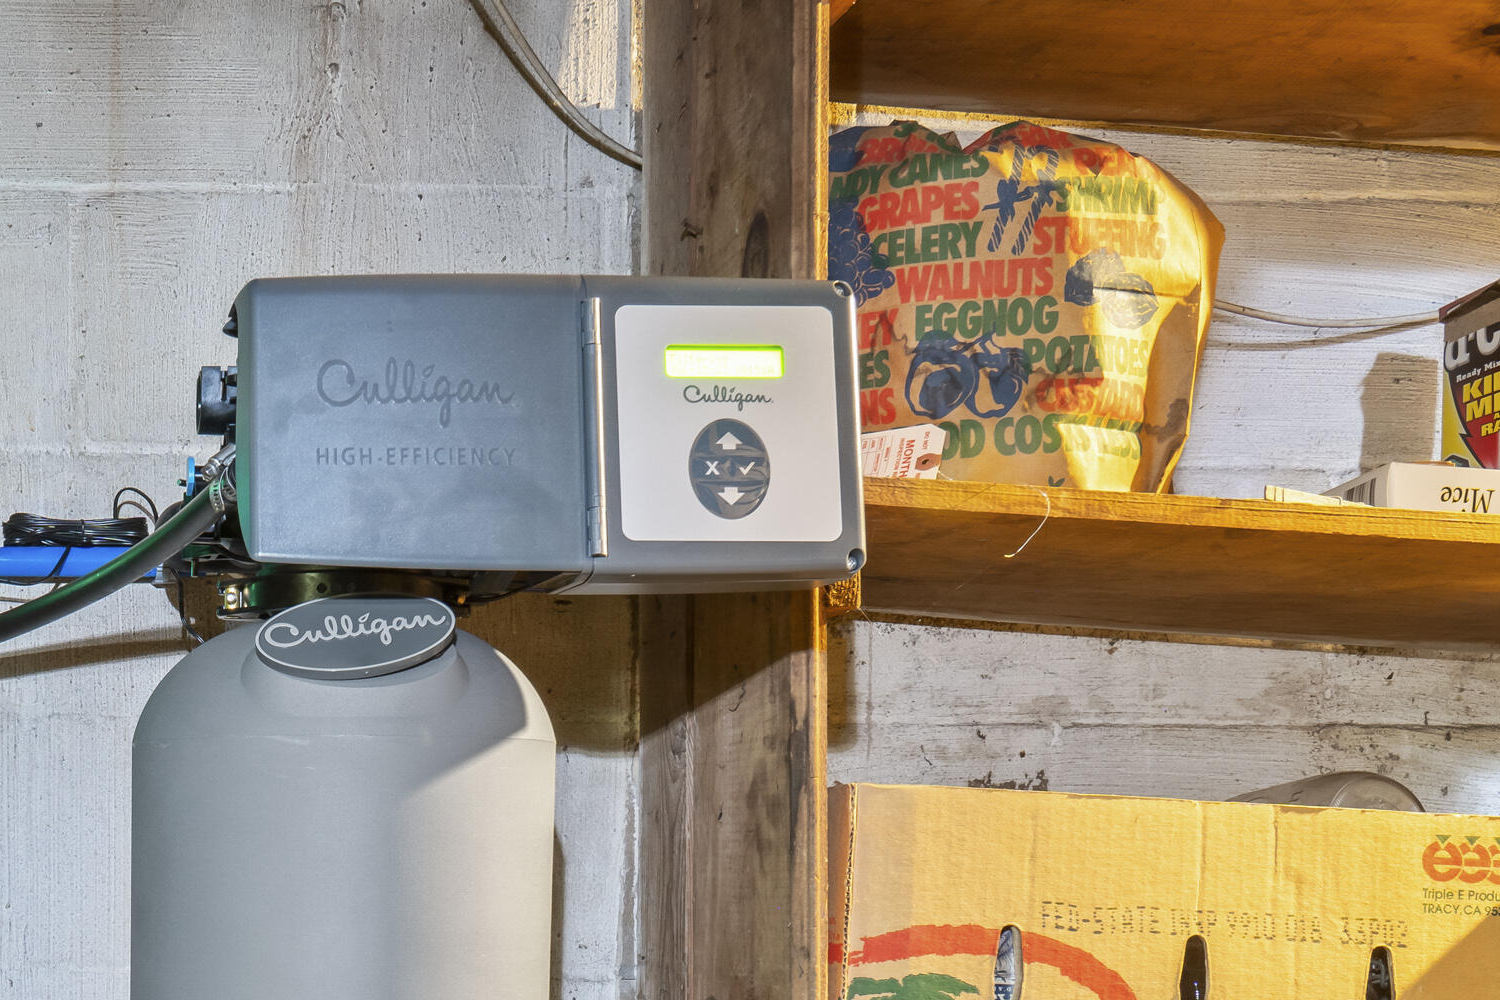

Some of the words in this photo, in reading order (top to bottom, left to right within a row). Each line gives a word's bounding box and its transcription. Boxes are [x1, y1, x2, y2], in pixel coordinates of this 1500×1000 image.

[889, 152, 990, 188] CANES
[857, 182, 979, 233] GRAPES
[872, 221, 982, 268] CELERY
[1033, 217, 1165, 260] STUFFING
[897, 257, 1054, 304] WALNUTS
[915, 296, 1059, 341] EGGNOG
[1023, 335, 1149, 377] POTATOES
[1456, 368, 1482, 383] Ready
[316, 357, 514, 428] Culligan
[683, 384, 771, 411] Culligan
[1441, 486, 1495, 513] Mice
[264, 609, 448, 647] Culligan
[1423, 888, 1454, 901] Triple
[1458, 890, 1464, 900] E
